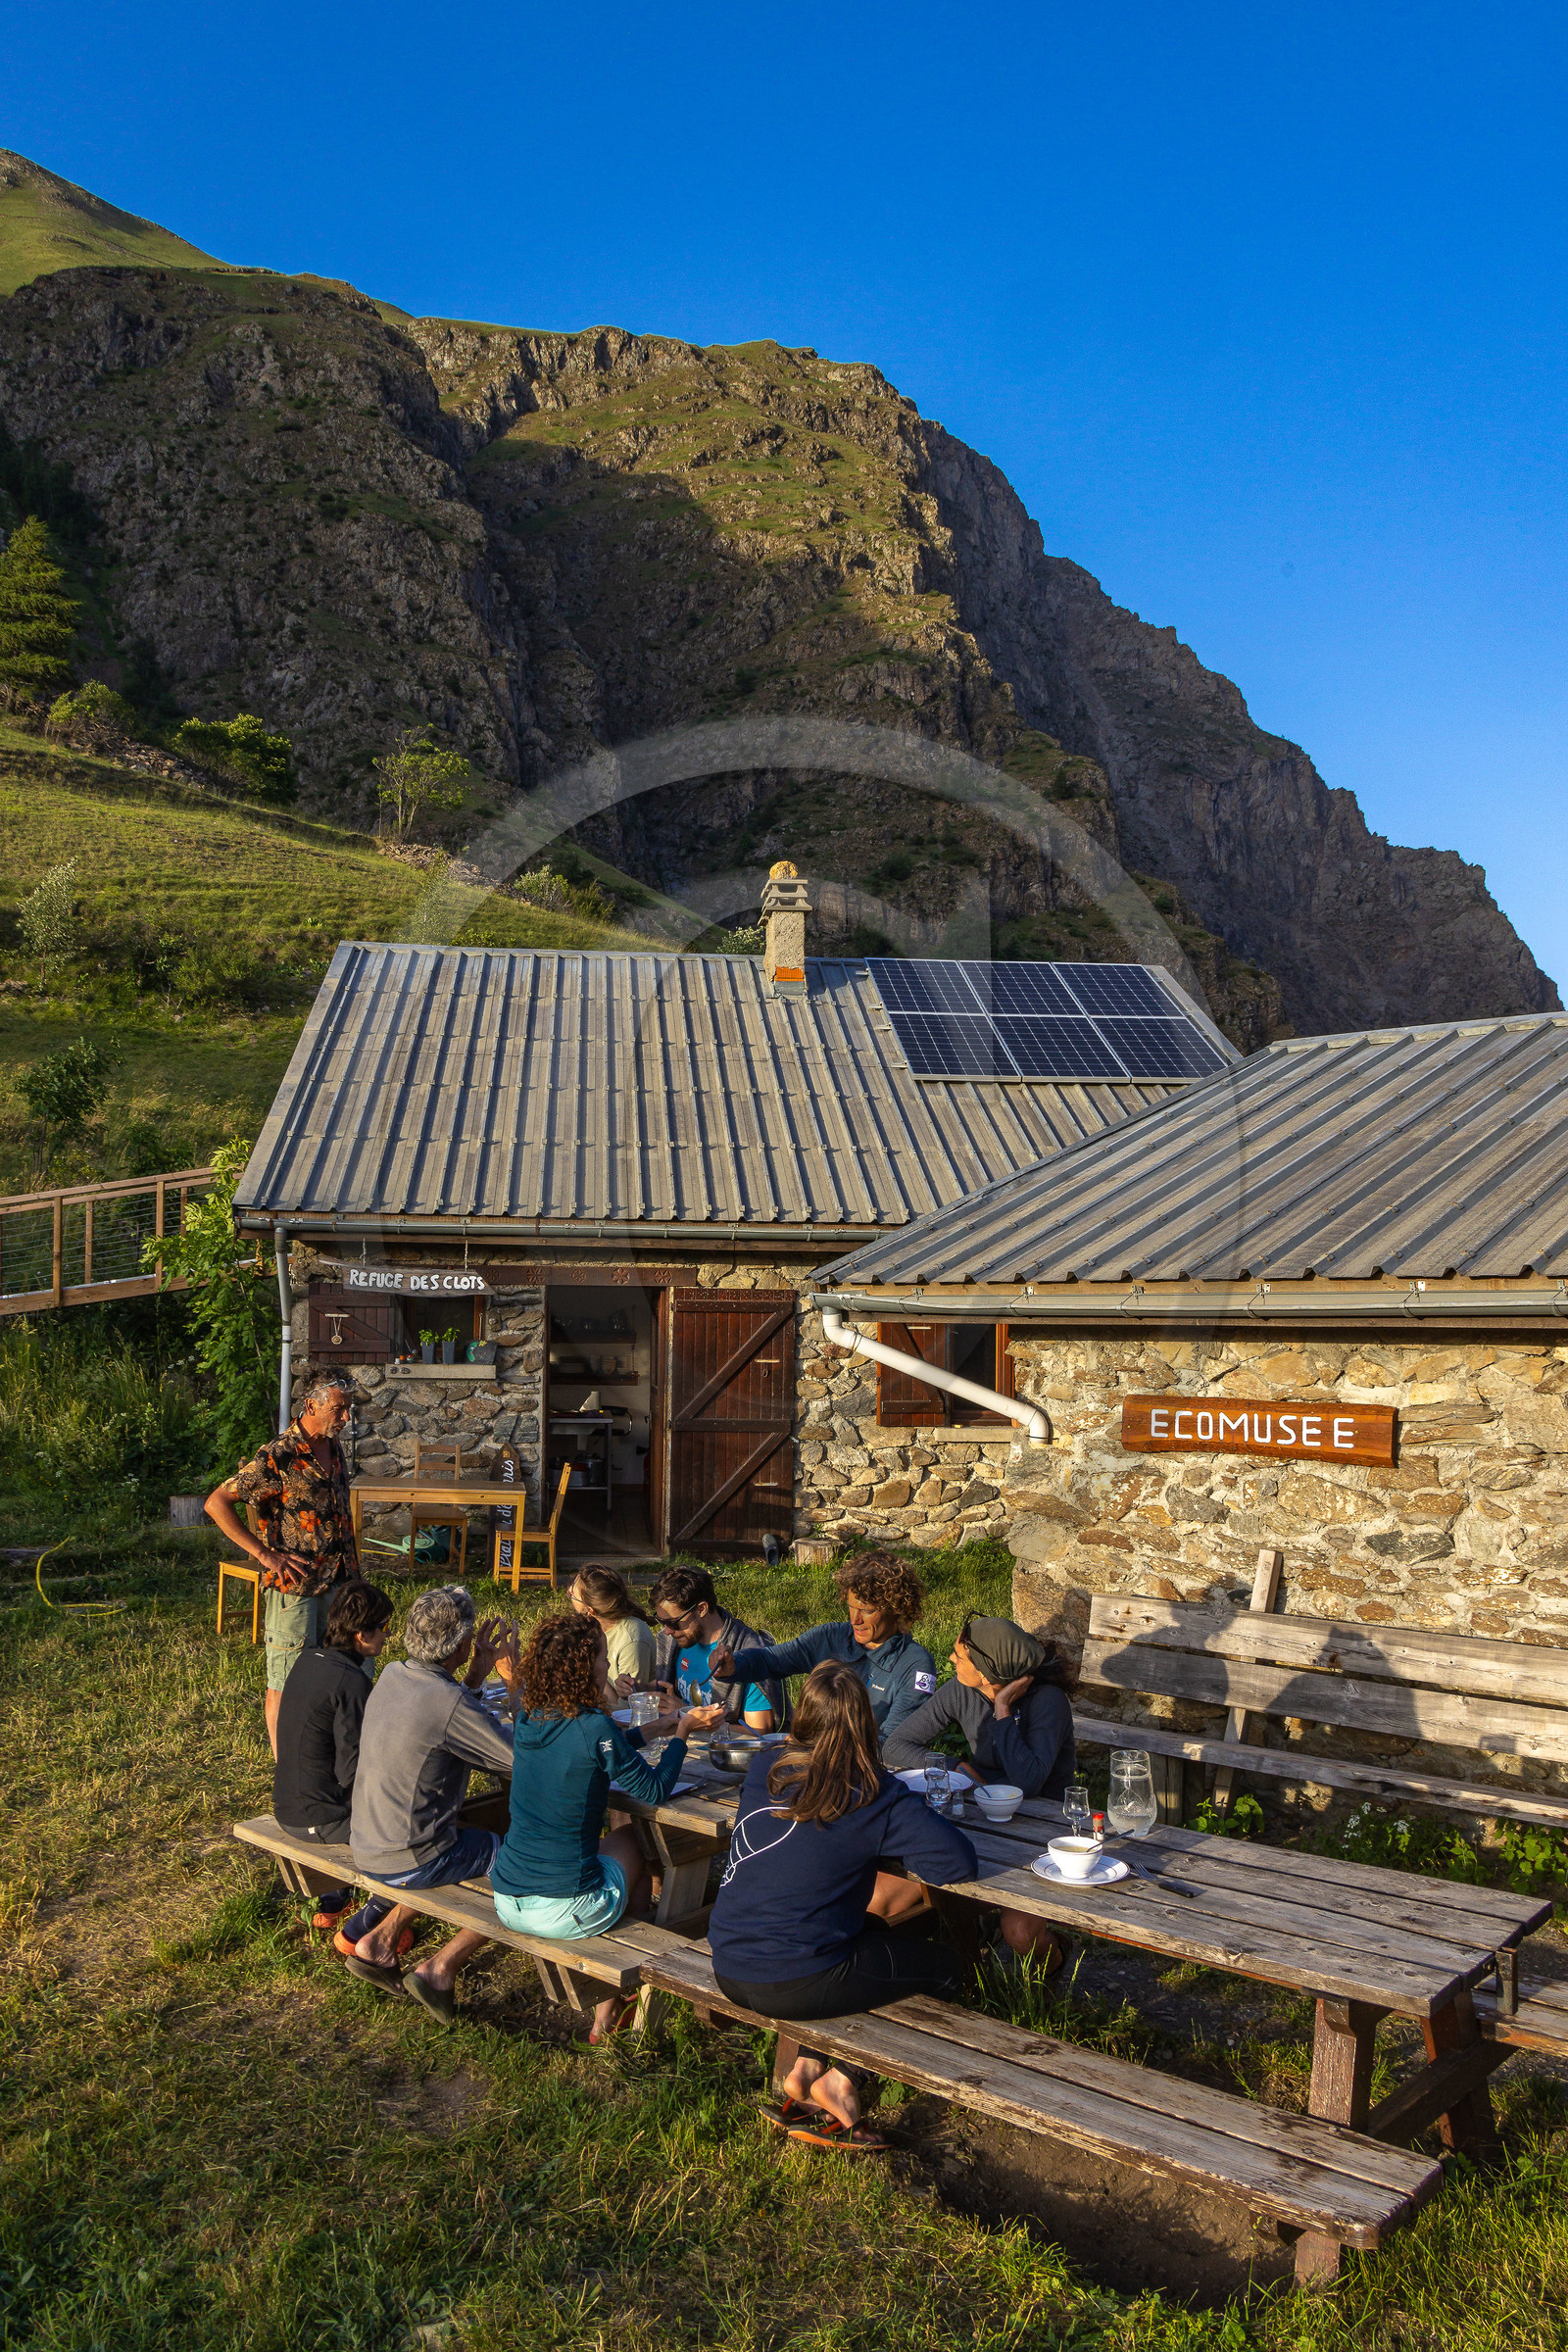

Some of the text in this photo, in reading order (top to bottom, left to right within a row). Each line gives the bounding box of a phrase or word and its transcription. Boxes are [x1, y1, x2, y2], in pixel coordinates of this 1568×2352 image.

[349, 1268, 486, 1291] REFUGE DES CLOTS
